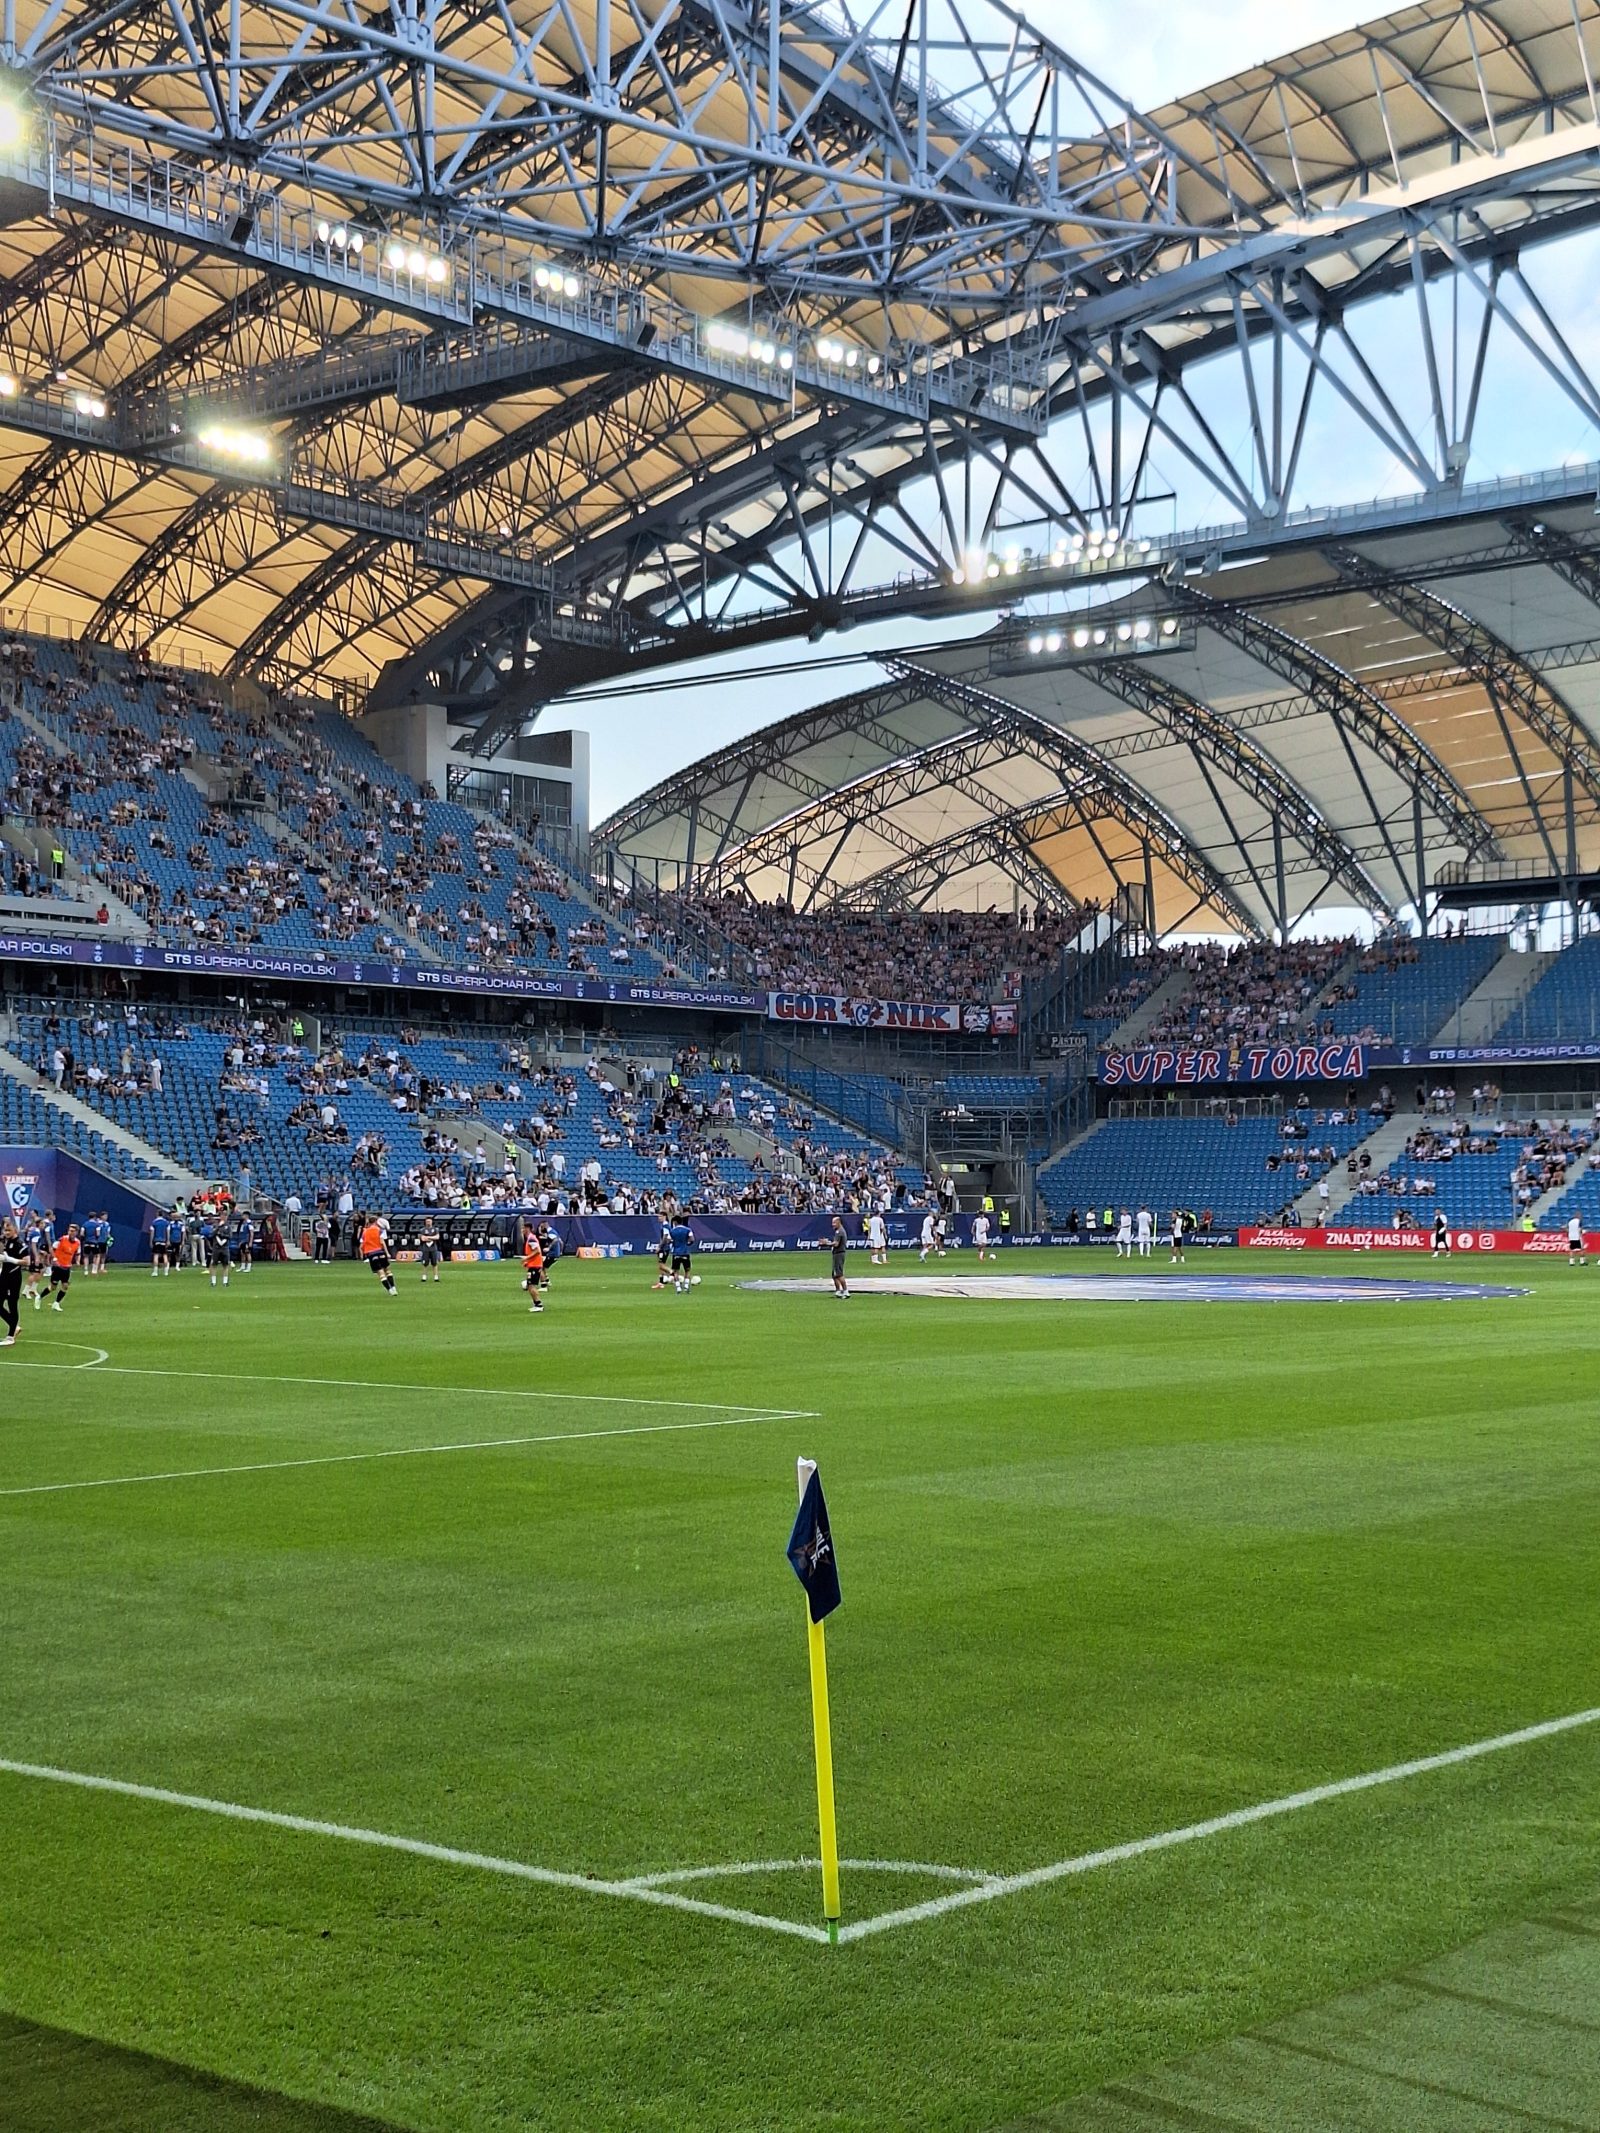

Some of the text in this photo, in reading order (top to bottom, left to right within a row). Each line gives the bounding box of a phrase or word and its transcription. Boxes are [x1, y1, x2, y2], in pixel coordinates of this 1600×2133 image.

[21, 942, 72, 956] POLSKI
[164, 953, 336, 977] STS SUPERPUCHAR POLSKI
[416, 972, 562, 993] STS SUPERPUCHAR POLSKI
[630, 988, 755, 1005] STS SUPERPUCHAR POLSKI
[1429, 1050, 1456, 1060] STS
[1457, 1047, 1556, 1059] SUPERPUCHAR
[1103, 1045, 1363, 1085] SUPER TORCA
[1326, 1231, 1425, 1247] ZNAJDŹ NAS NA:
